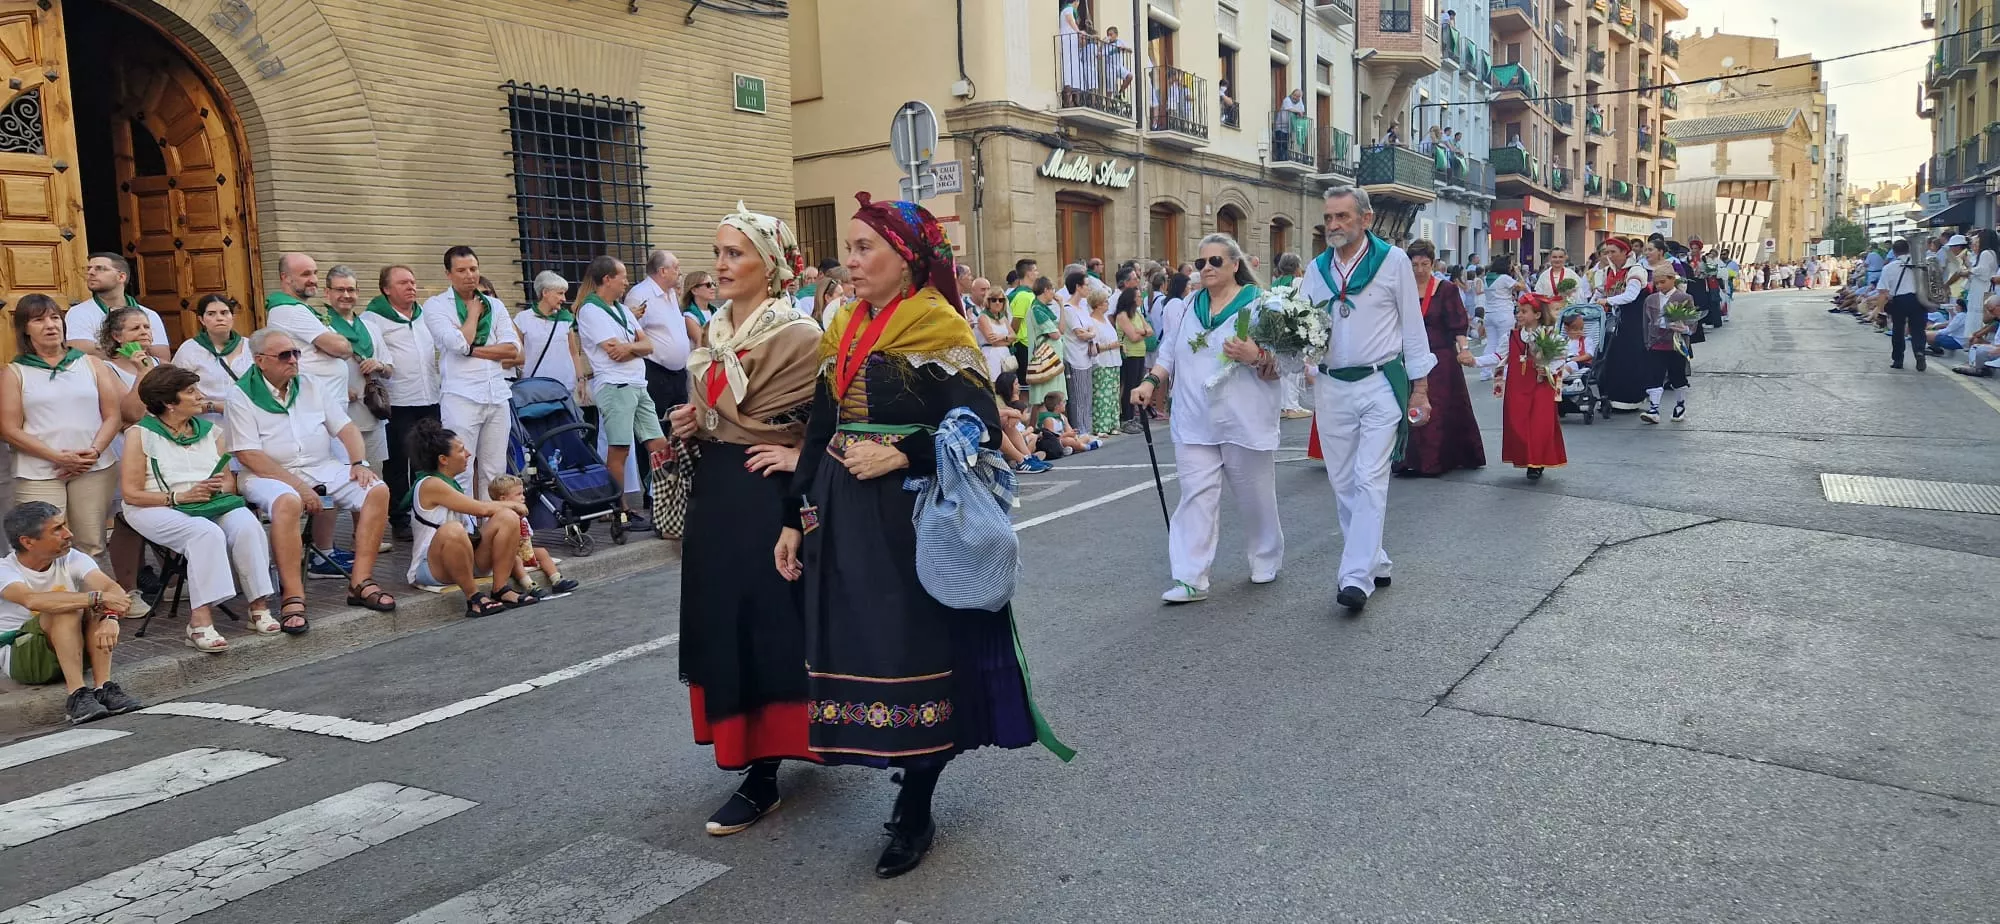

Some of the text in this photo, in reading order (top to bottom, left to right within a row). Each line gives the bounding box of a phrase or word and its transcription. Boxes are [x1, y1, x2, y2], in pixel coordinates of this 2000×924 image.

[1041, 147, 1135, 188] Muebles Arnal
[939, 173, 954, 181] SAN
[937, 180, 956, 188] ORGE
